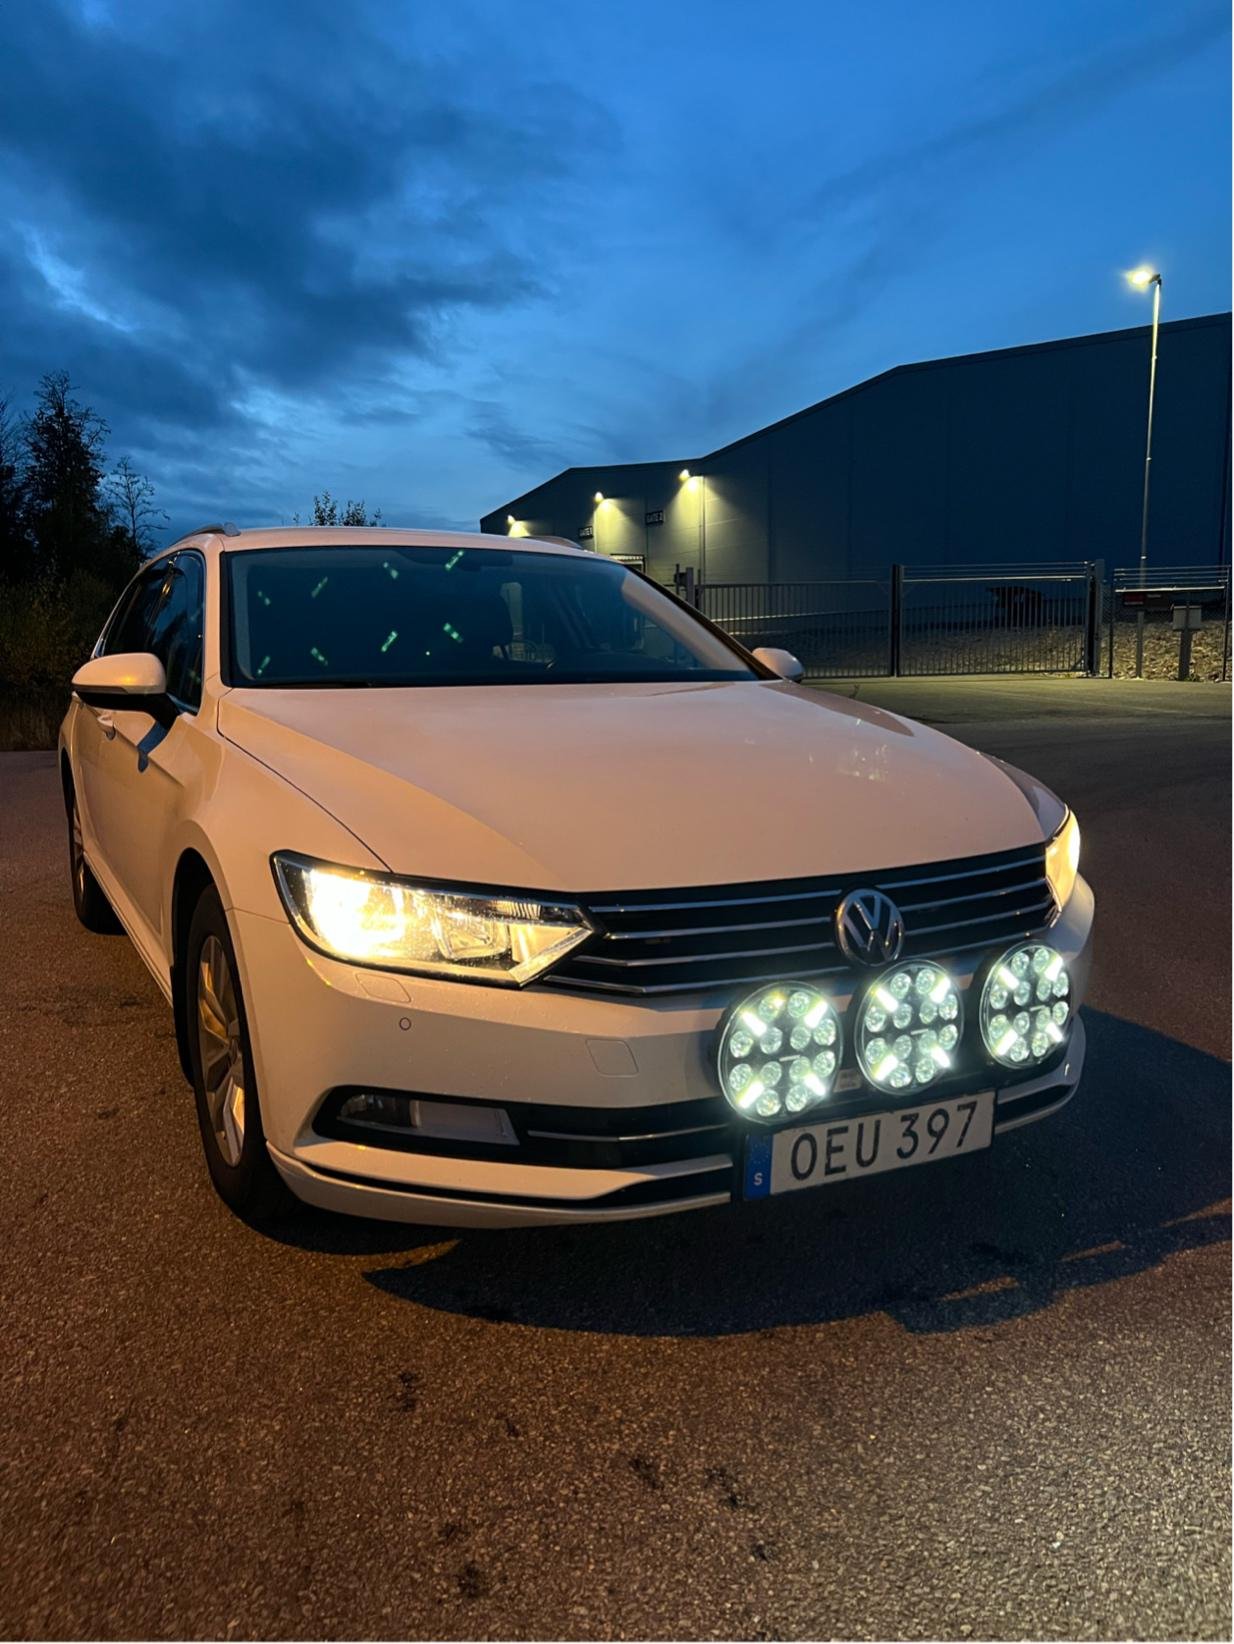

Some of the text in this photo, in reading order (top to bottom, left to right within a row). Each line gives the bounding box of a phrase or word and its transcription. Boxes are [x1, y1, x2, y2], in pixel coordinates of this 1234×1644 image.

[790, 1101, 978, 1181] OEU 397
[753, 1172, 763, 1186] S
